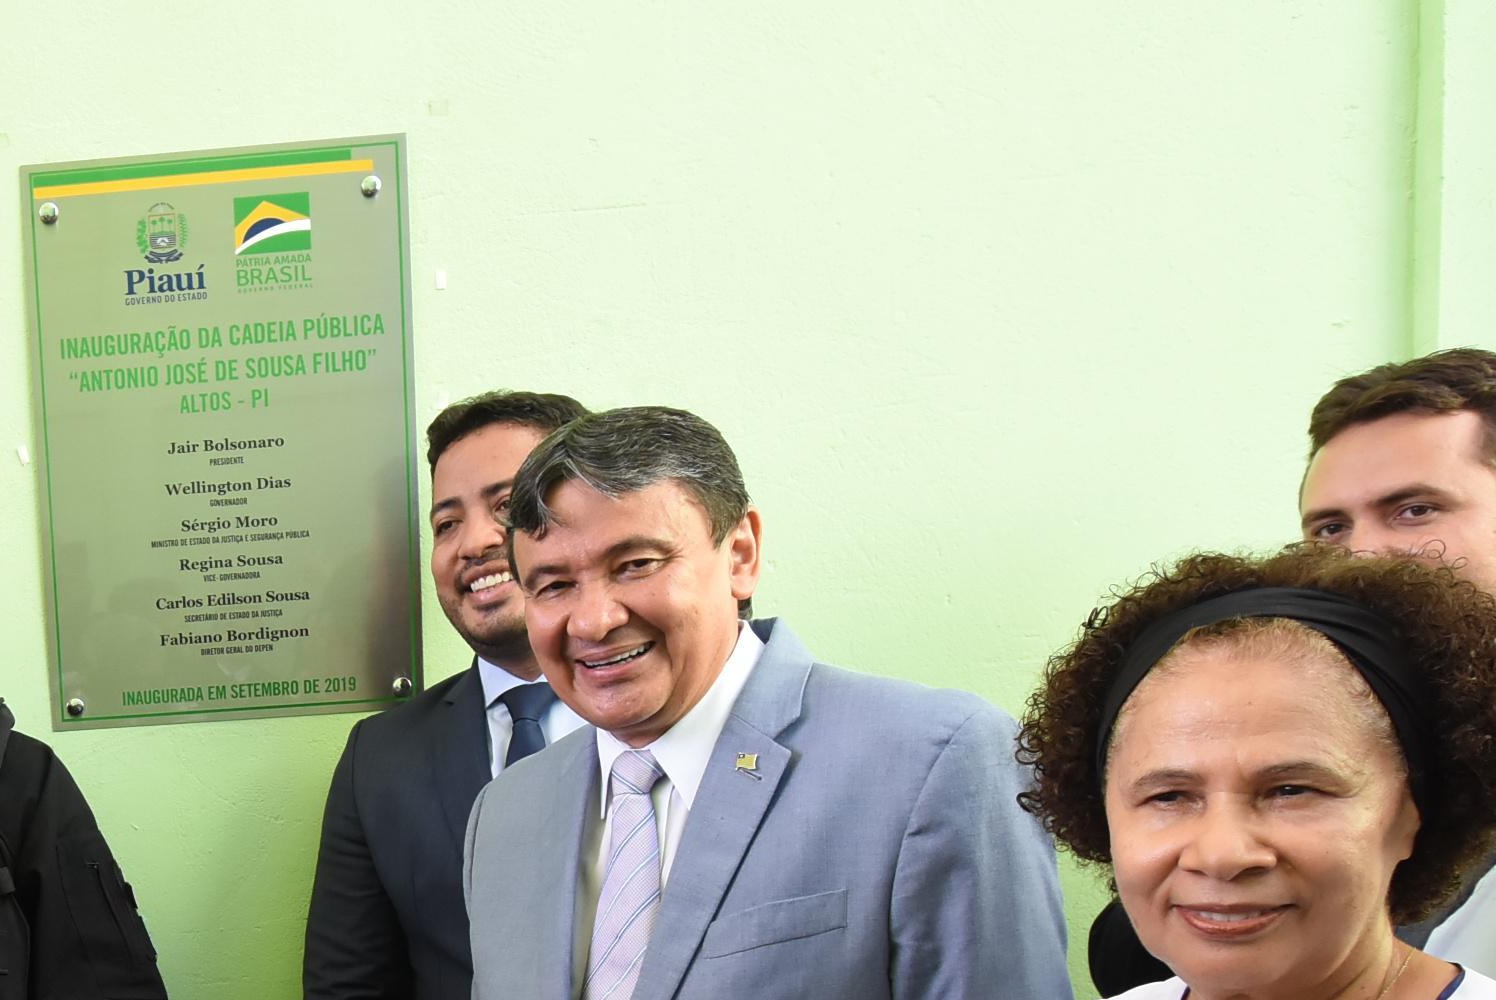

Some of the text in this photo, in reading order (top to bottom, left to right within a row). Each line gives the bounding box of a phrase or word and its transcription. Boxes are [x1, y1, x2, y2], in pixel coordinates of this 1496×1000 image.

[273, 253, 312, 264] AMADA
[123, 264, 207, 295] Piauí
[236, 264, 313, 286] BRASIL
[125, 292, 208, 306] GOVERNO DO ESTADO
[60, 313, 385, 360] INAUGURAÇÃO DA CADEIA PÚBLICA
[165, 356, 208, 386] JOSÉ
[215, 359, 239, 381] DE
[245, 354, 306, 379] SOUSA
[180, 391, 232, 414] ALTOS
[251, 388, 269, 409] PI
[167, 437, 284, 454] Jair Bolsonaro
[209, 456, 244, 466] PRESIDENTE
[164, 476, 291, 496] Wellington Dias
[209, 497, 248, 507] GOVERNADOR
[181, 516, 278, 533] Sérgio Moro
[151, 540, 179, 548] MINISTRO
[180, 539, 188, 547] DE
[189, 537, 211, 546] ESTADO
[212, 536, 220, 544] DA
[220, 535, 244, 545] JUSTIÇA
[250, 532, 284, 542] SEGURANÇA
[179, 554, 283, 573] Regina Sousa
[219, 571, 261, 581] GOVERNADORA
[156, 590, 310, 610] Carlos Edilson Sousa
[219, 612, 227, 620] DE
[228, 611, 250, 619] ESTADO
[251, 610, 259, 618] DA
[260, 608, 283, 618] JUSTIÇA
[160, 627, 310, 647] Fabiano Bordignon
[201, 644, 274, 656] DIRETOR GERAL DO DEPEN
[122, 676, 357, 706] INAUGURADA EM SETEMBRO DE 2019
